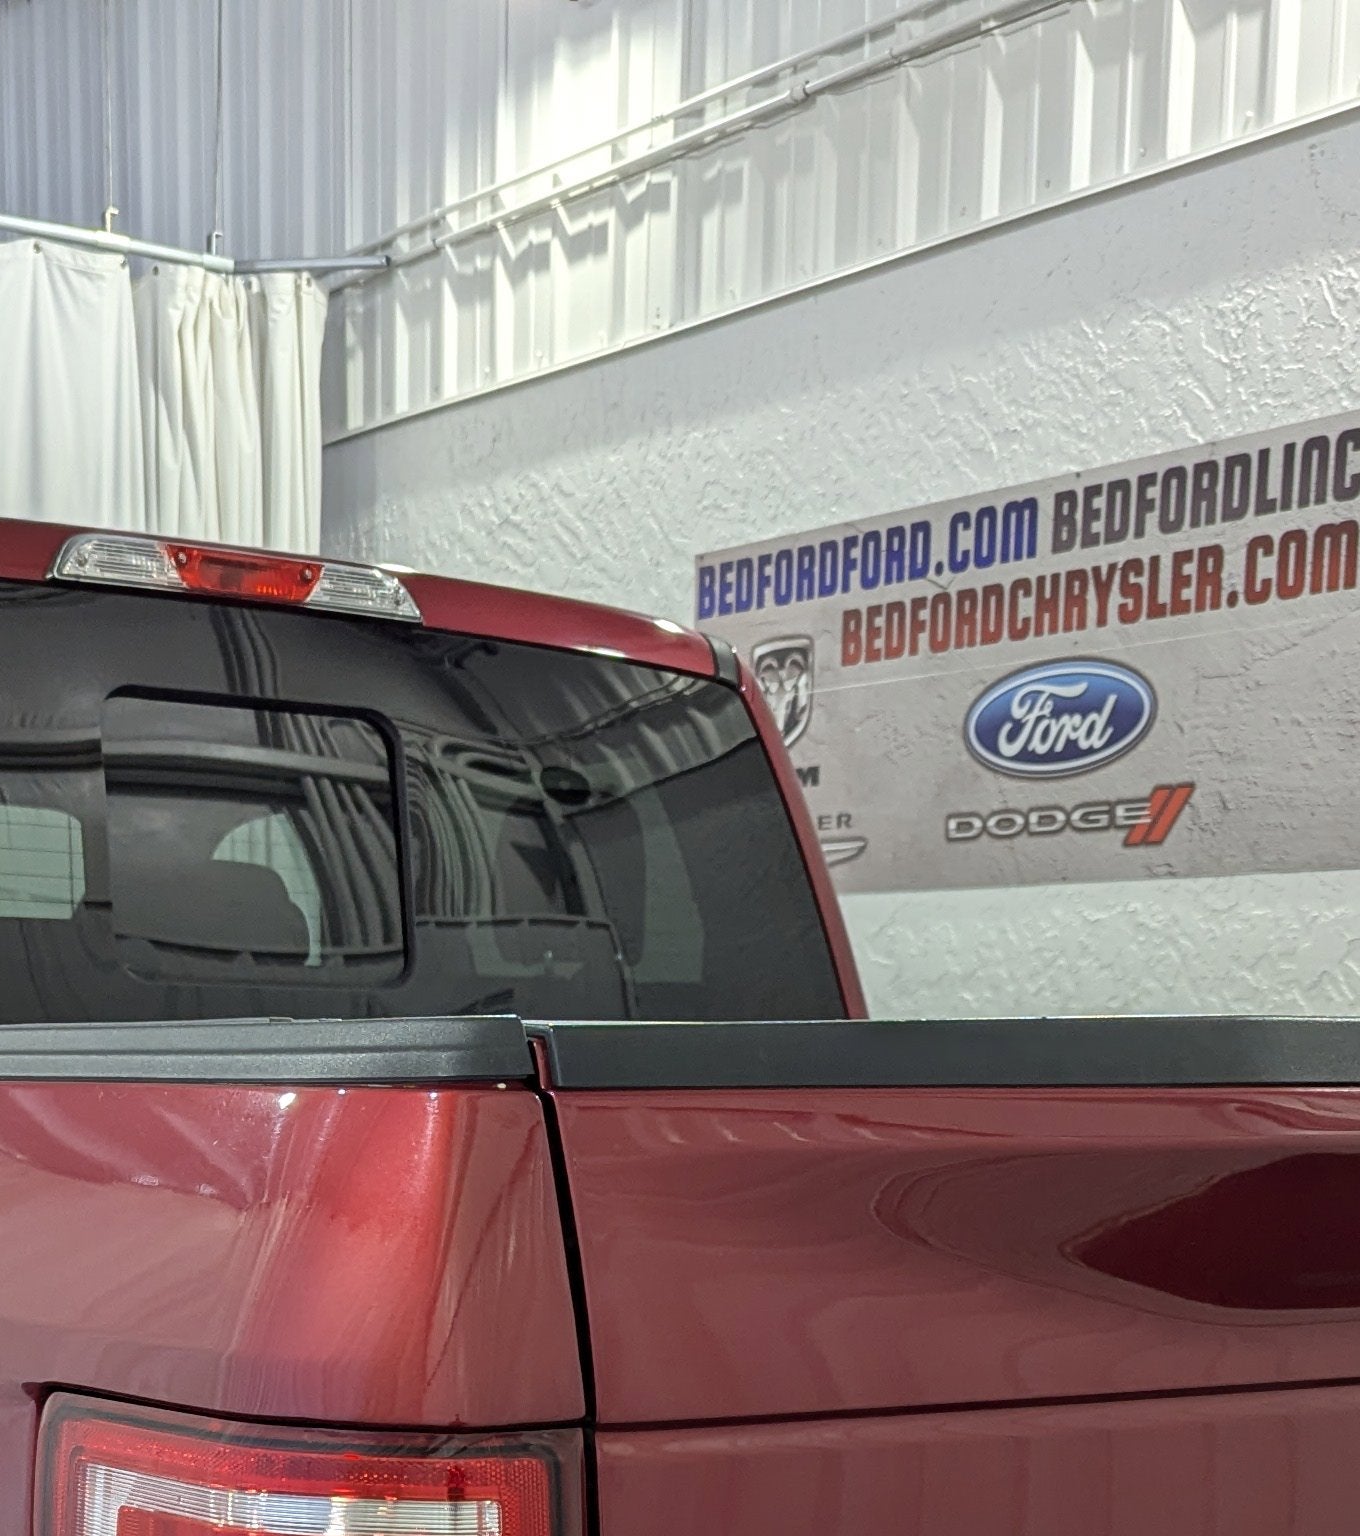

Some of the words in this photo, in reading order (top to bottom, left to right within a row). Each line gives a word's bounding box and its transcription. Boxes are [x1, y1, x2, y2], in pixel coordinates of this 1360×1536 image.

[697, 496, 1039, 621] BEDFORDFORD.COM
[840, 519, 1360, 668] BEDFORDCHRYSLER.COM
[997, 682, 1118, 758] Ford
[945, 799, 1153, 842] DODGE
